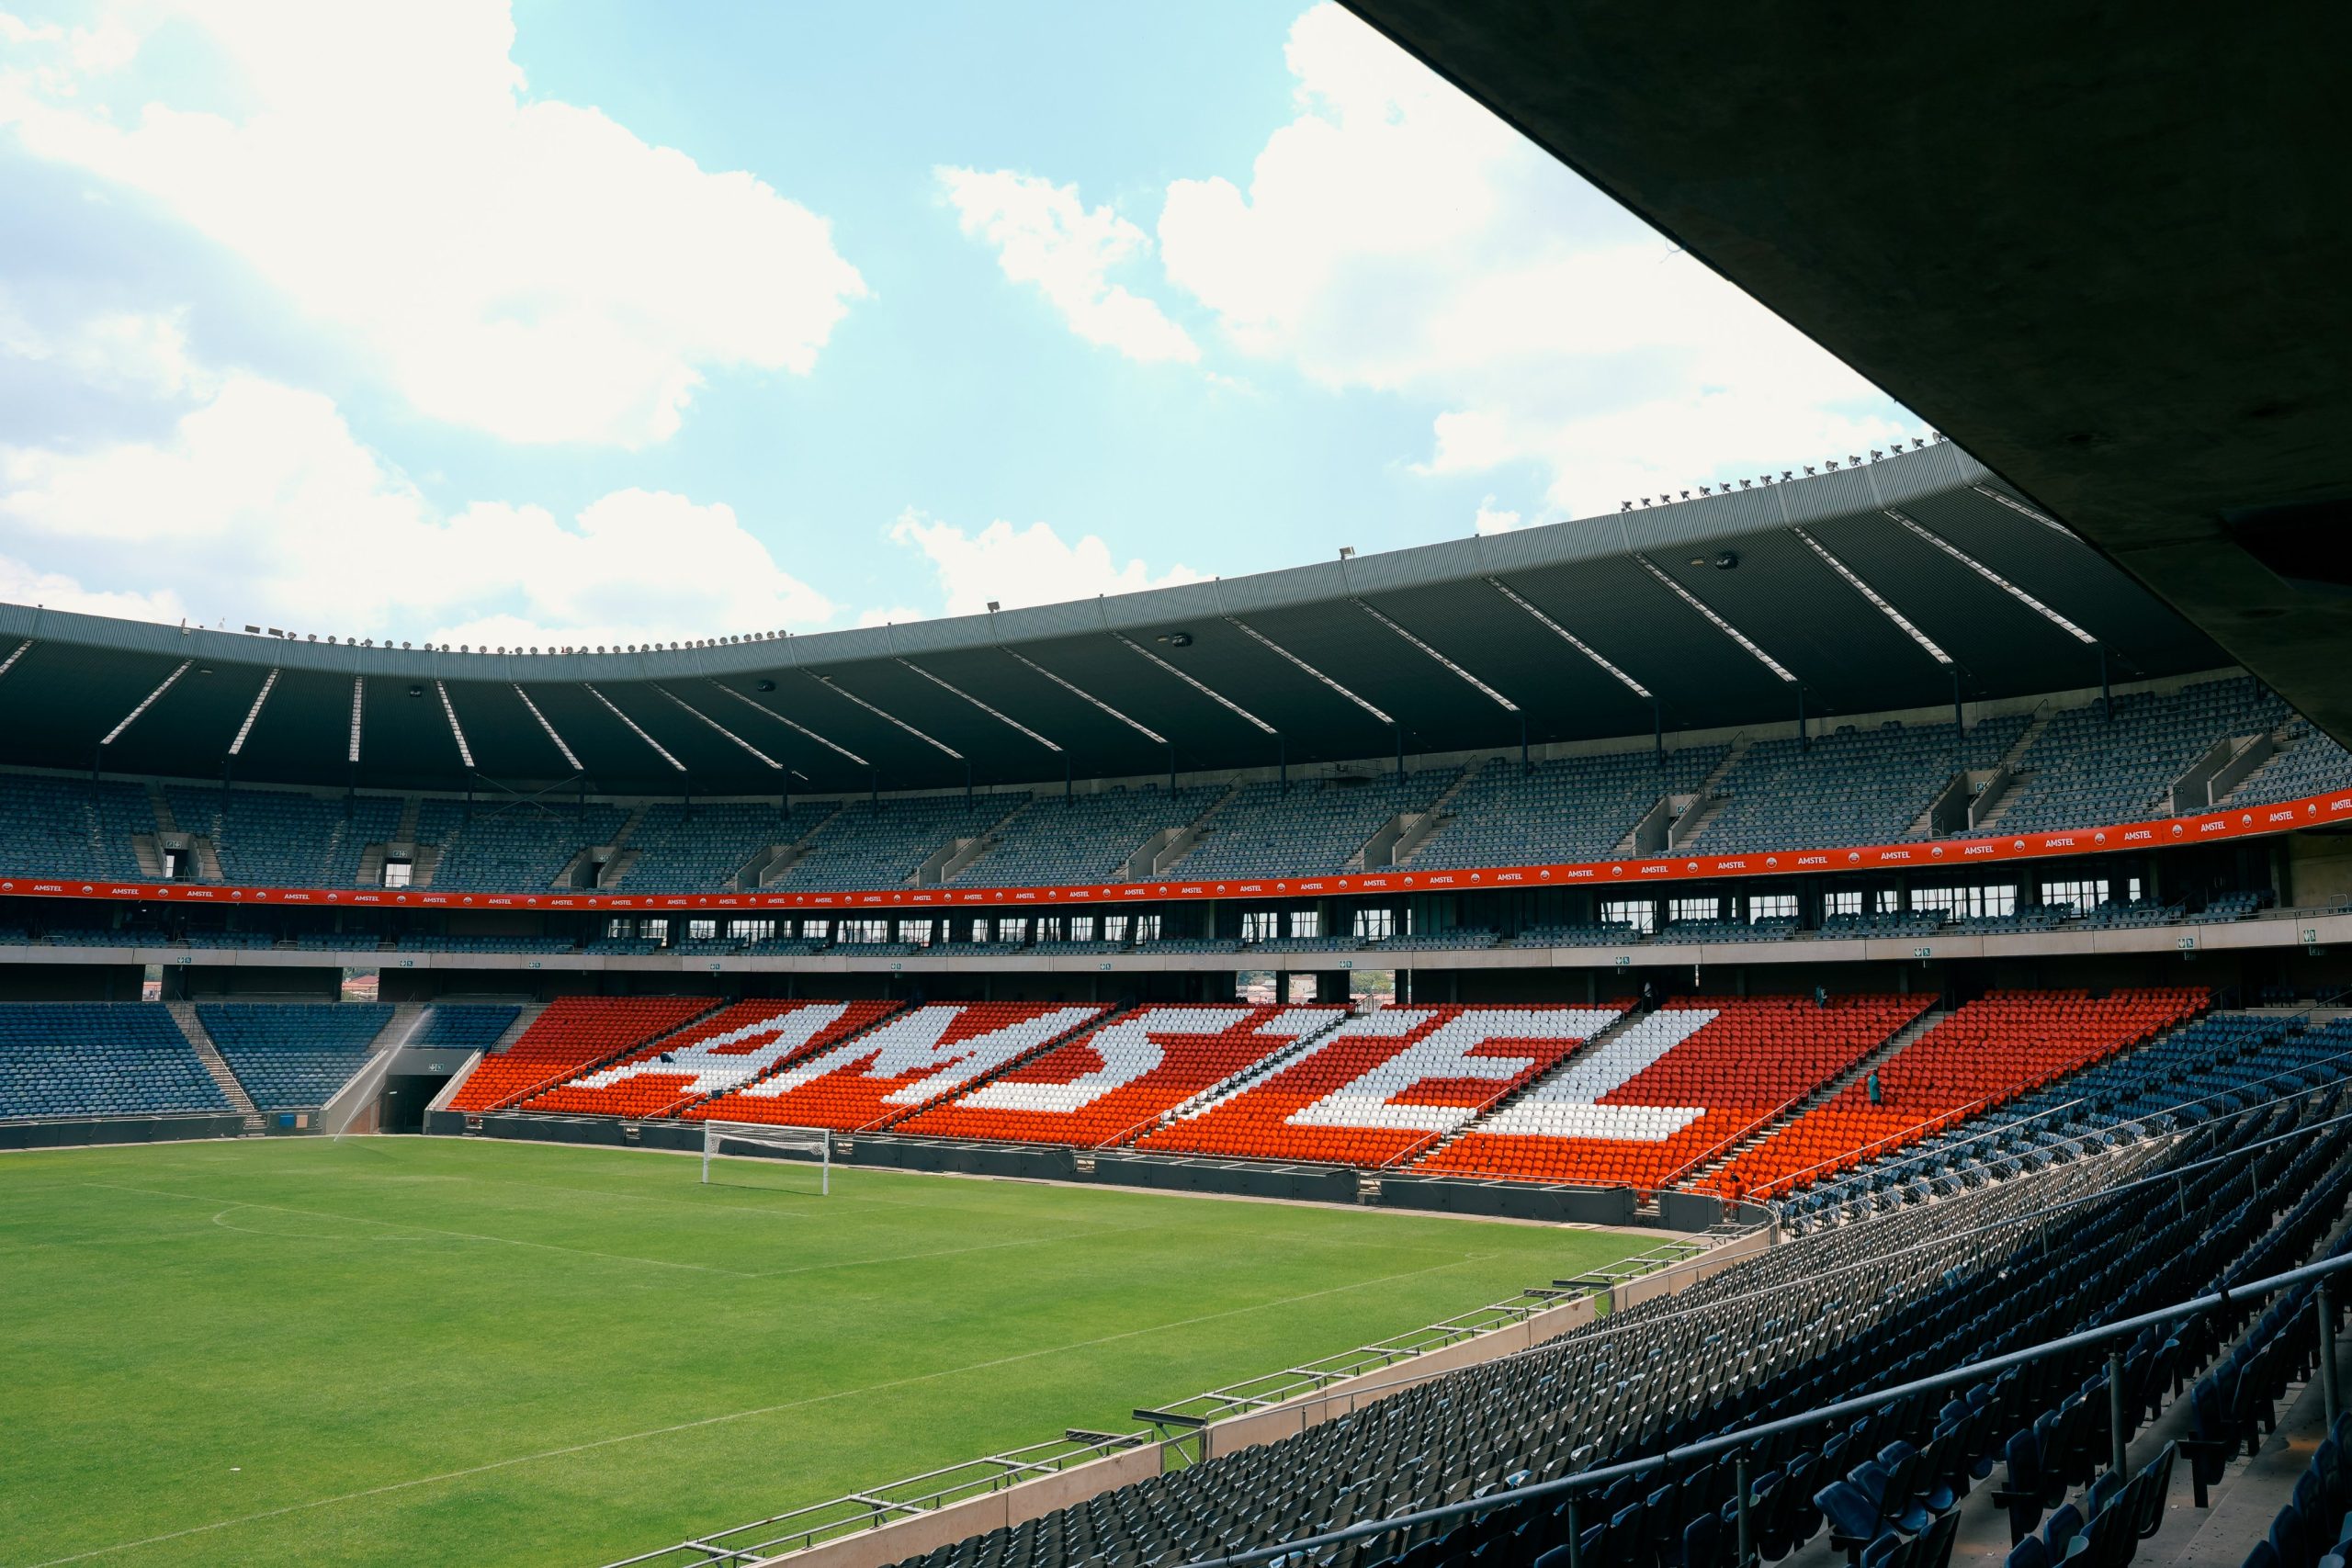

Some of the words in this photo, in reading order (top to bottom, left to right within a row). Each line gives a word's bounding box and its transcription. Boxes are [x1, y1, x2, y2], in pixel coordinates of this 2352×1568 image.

[2331, 799, 2352, 811] AMSTEL
[2269, 811, 2293, 822] AMSTEL
[2201, 821, 2225, 832] AMSTEL
[2124, 829, 2152, 841] AMSTEL
[2045, 837, 2075, 848] AMSTEL
[1964, 844, 1994, 855] AMSTEL
[1798, 855, 1827, 865] AMSTEL
[1881, 851, 1911, 861] AMSTEL
[1641, 864, 1668, 874] AMSTEL
[1718, 861, 1746, 870] AMSTEL
[1498, 873, 1522, 882] AMSTEL
[1568, 869, 1594, 878] AMSTEL
[1363, 878, 1386, 887] AMSTEL
[1430, 875, 1453, 885] AMSTEL
[1240, 885, 1261, 893] AMSTEL
[1301, 882, 1323, 890] AMSTEL
[112, 887, 139, 896] AMSTEL
[567, 1003, 1719, 1142] AMSTEL
